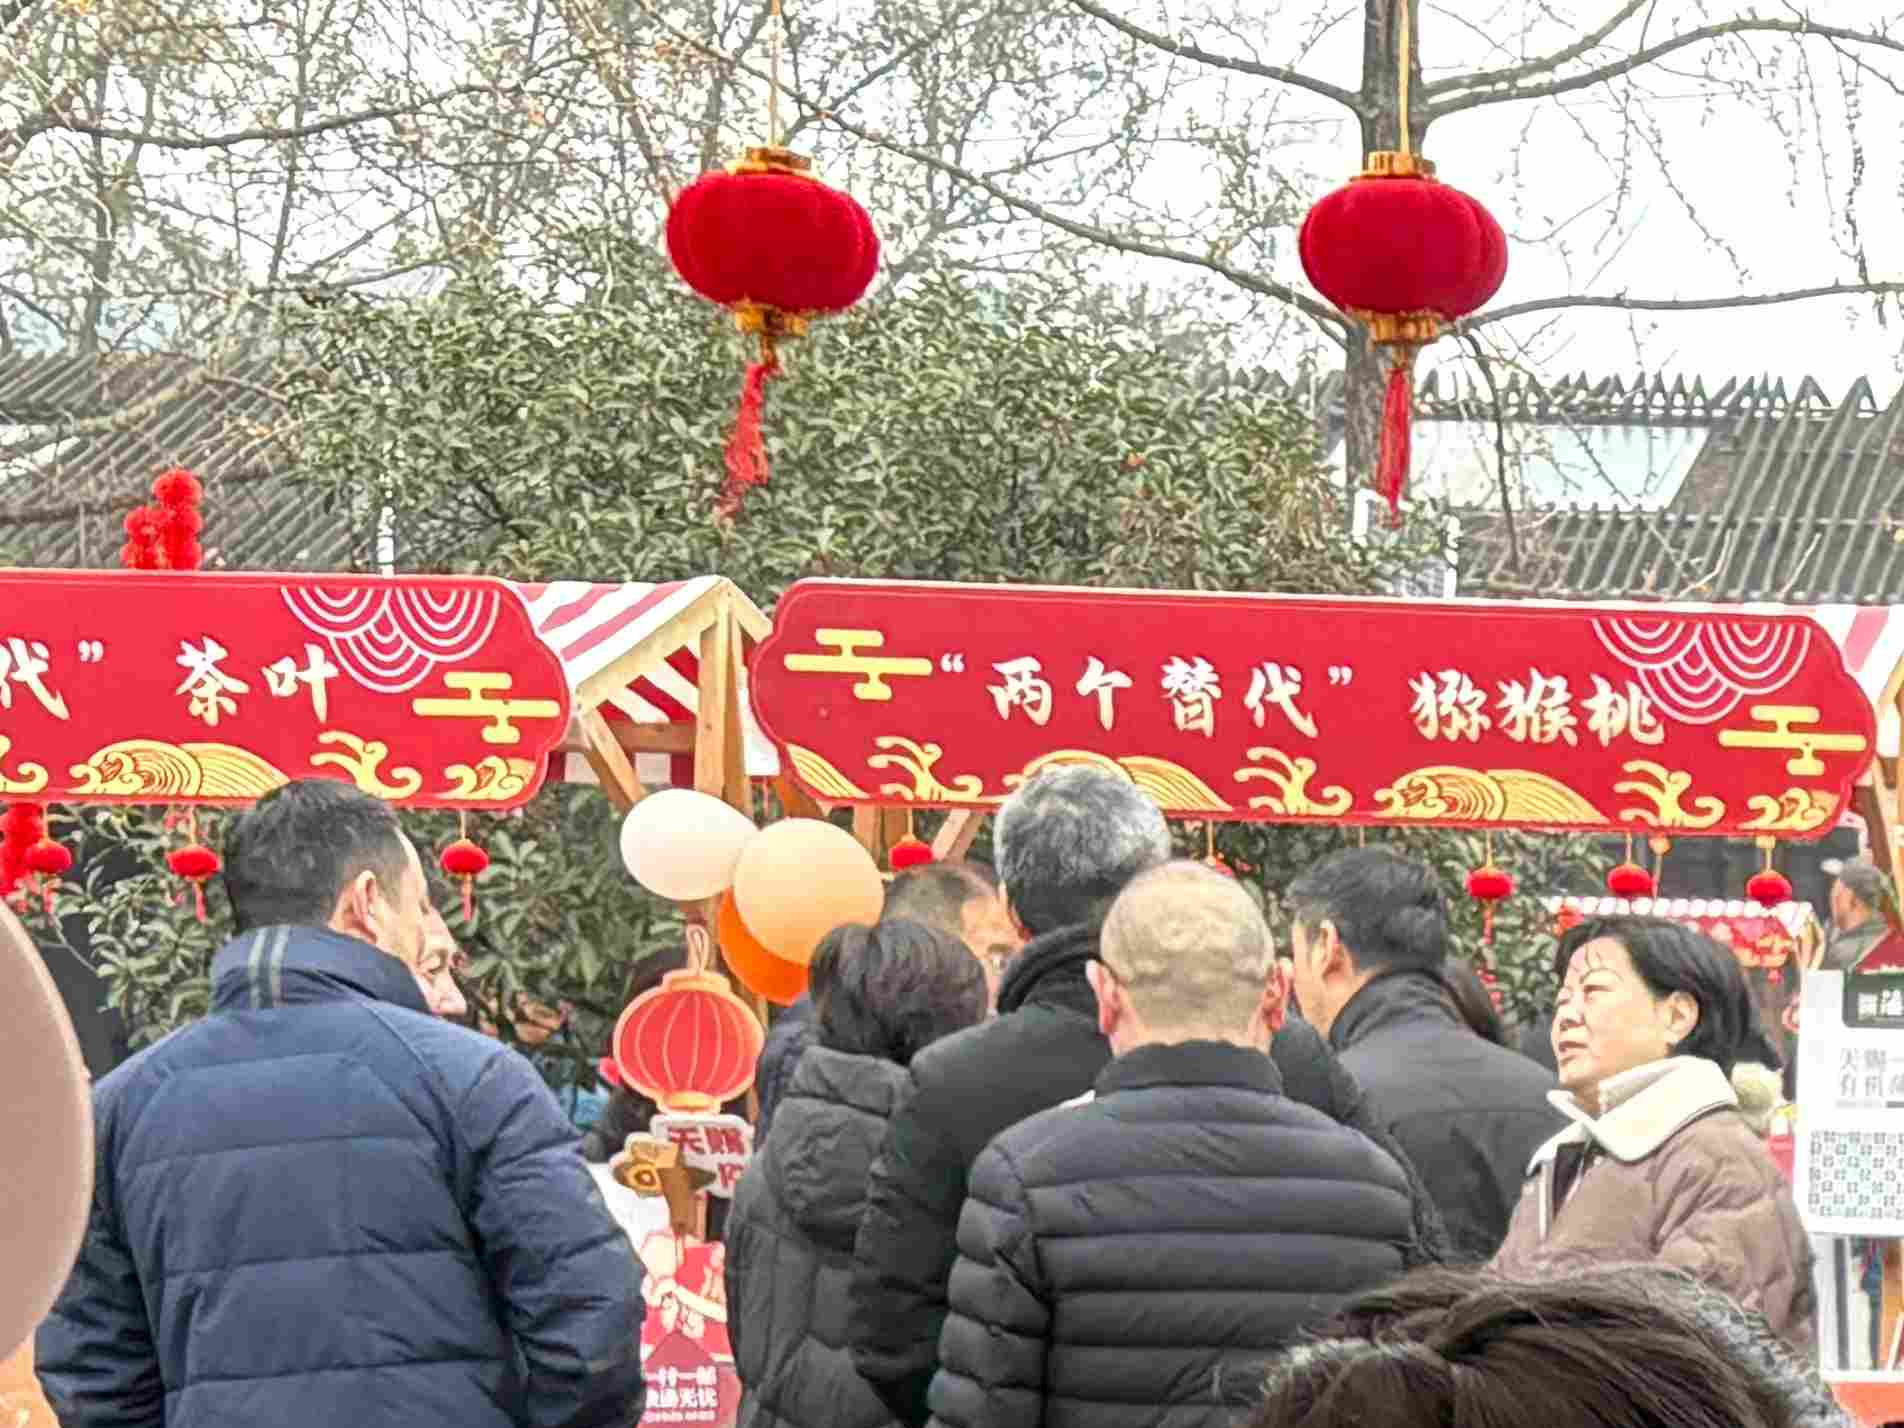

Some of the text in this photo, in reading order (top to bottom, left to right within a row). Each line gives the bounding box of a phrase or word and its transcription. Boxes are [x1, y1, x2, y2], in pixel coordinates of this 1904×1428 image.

[175, 634, 340, 726] 茶叶
[1408, 666, 1666, 747] 猕猴桃
